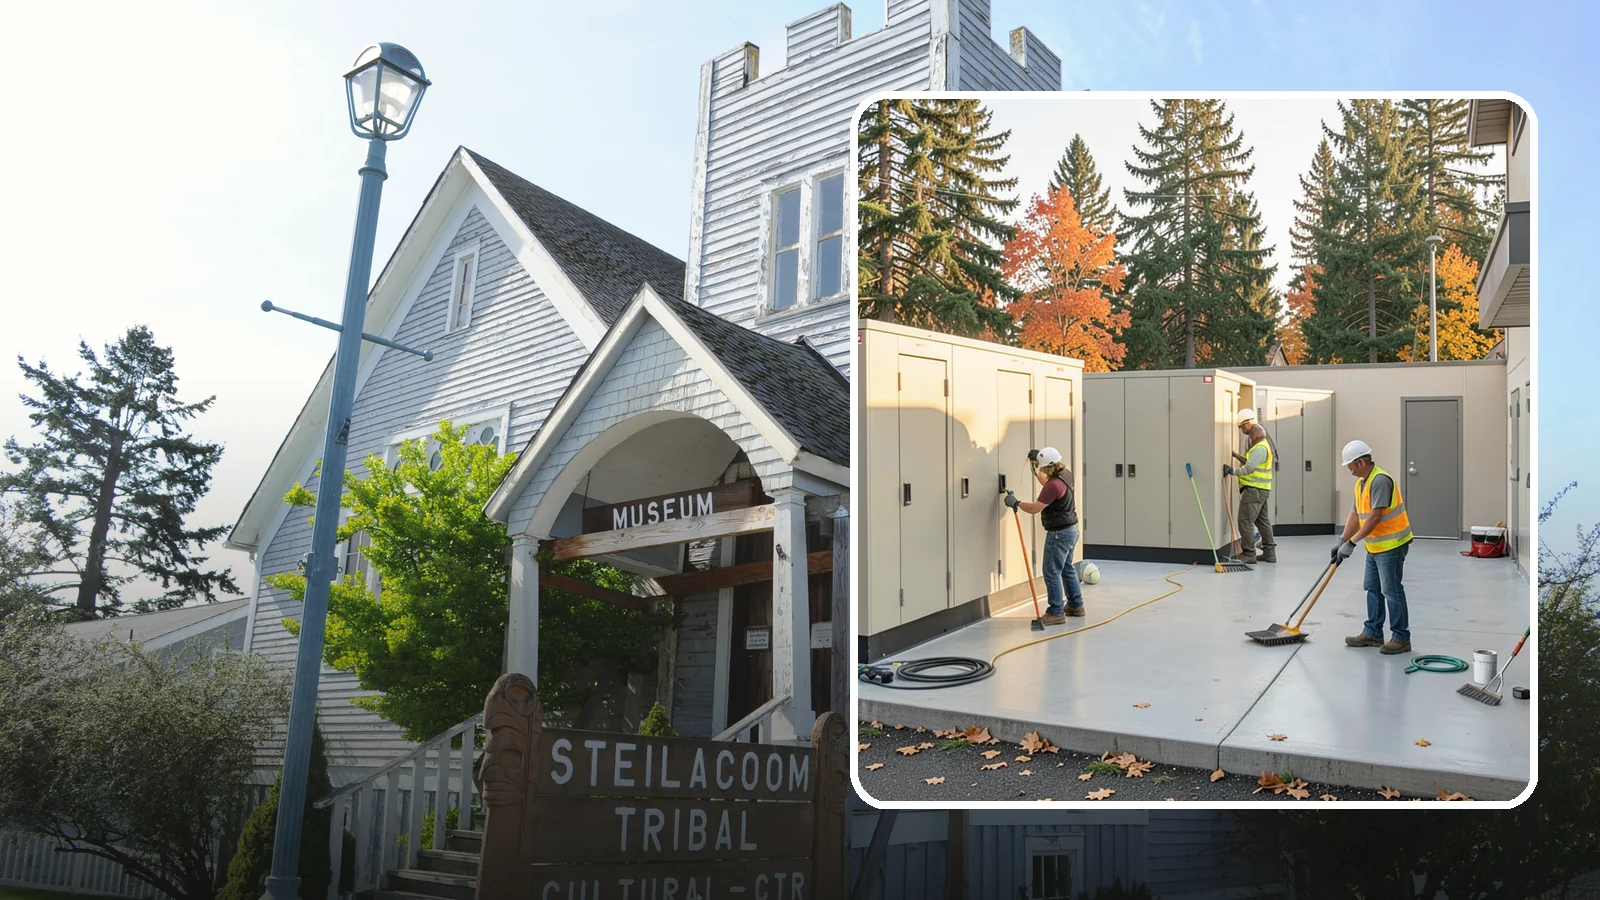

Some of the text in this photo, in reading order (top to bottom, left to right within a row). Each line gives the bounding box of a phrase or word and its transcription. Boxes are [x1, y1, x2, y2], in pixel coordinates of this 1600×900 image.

[613, 492, 713, 530] MUSEUM
[551, 738, 809, 792] STEILACOOM
[615, 807, 757, 852] TRIBAL
